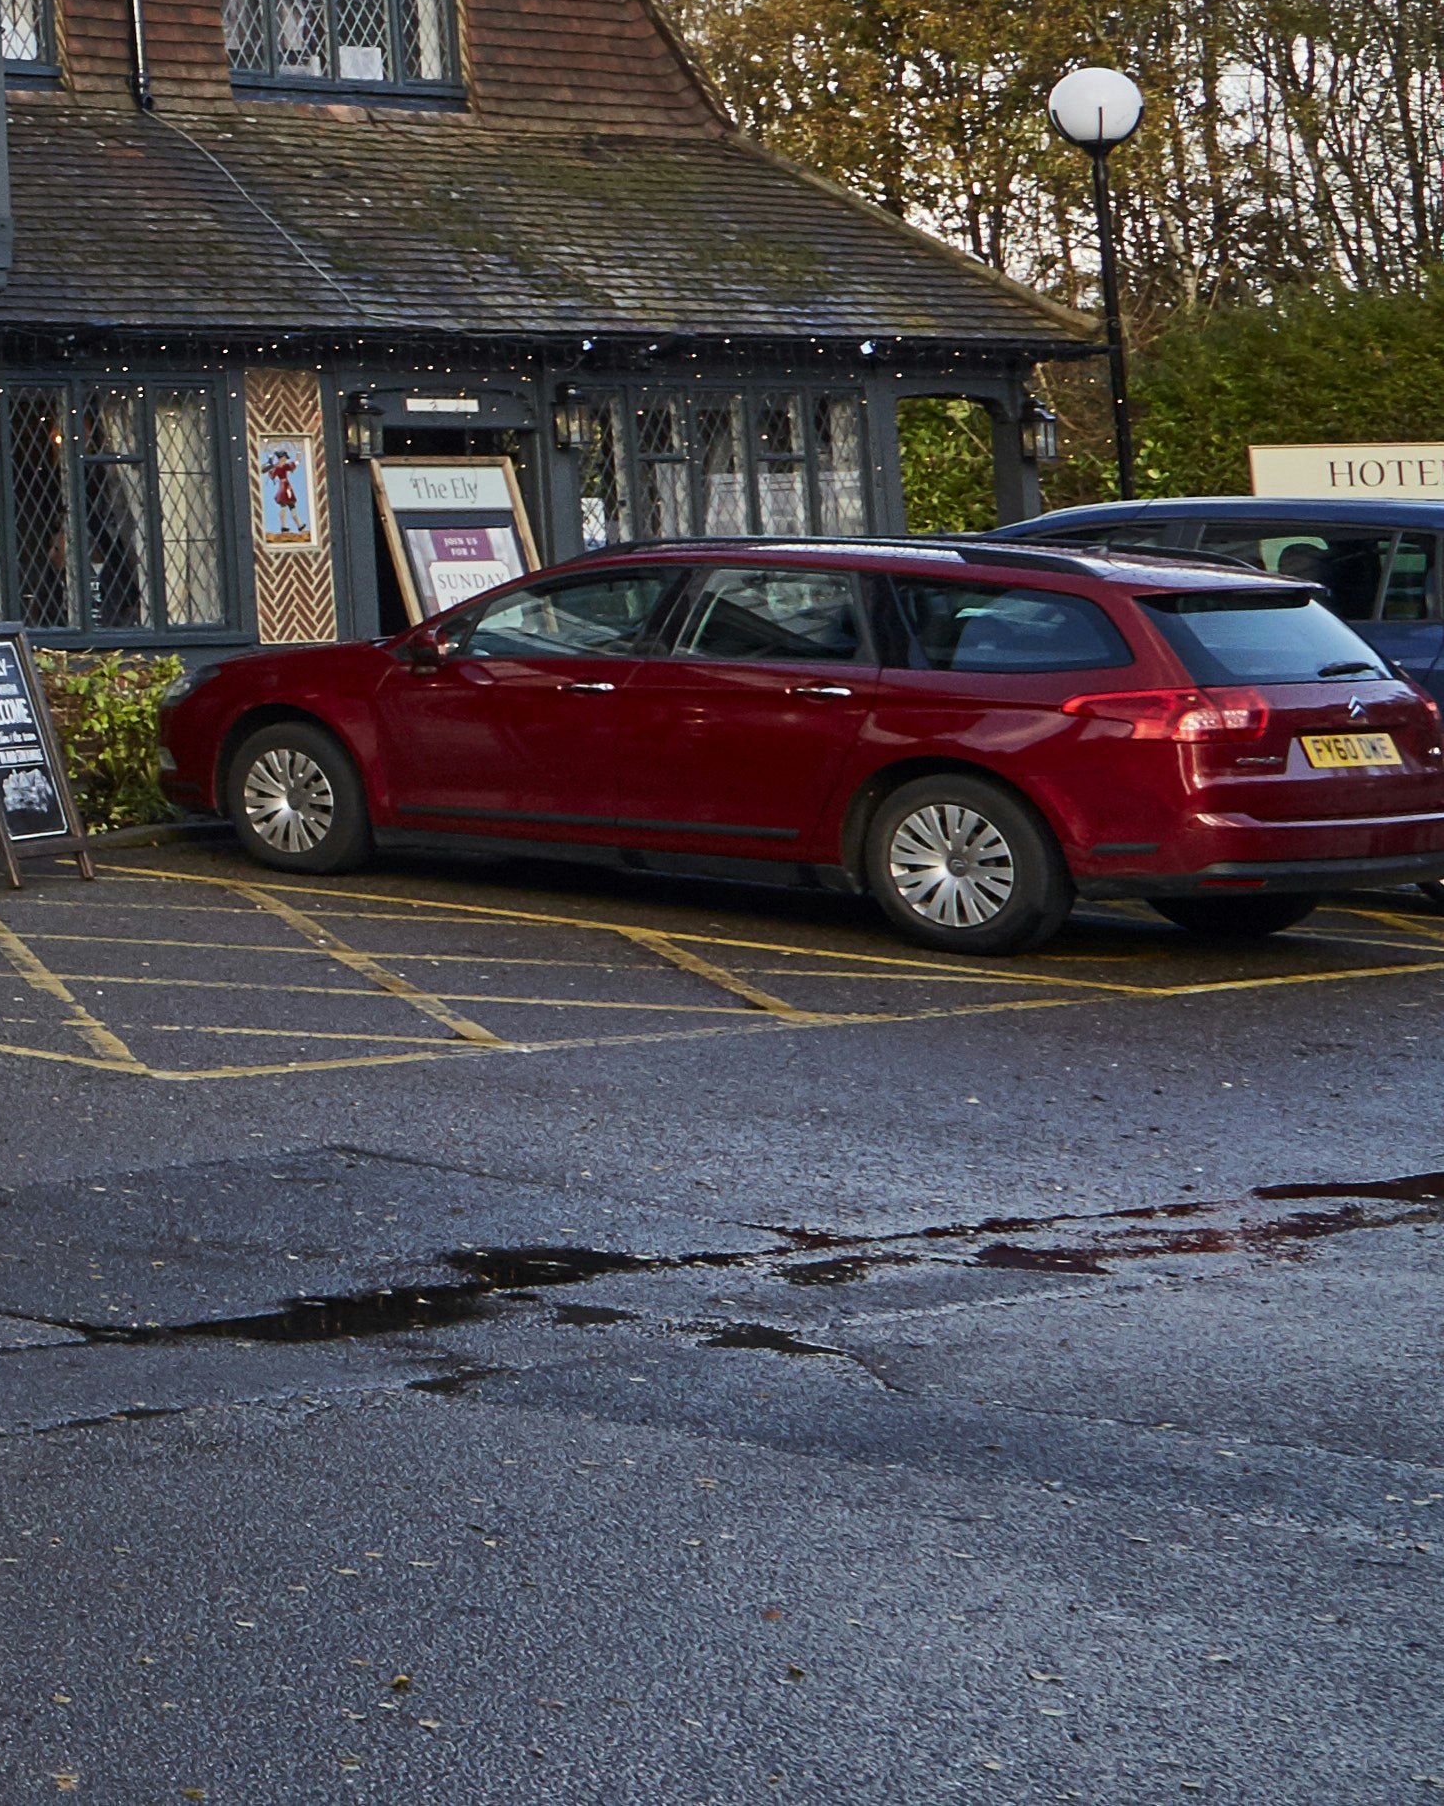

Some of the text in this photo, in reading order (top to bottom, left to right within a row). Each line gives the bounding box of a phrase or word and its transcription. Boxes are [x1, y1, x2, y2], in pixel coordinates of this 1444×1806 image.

[1328, 459, 1444, 487] HOTE
[410, 476, 478, 504] The Ely
[444, 537, 478, 547] JOIN US
[451, 547, 477, 557] FOR A
[437, 573, 505, 590] SUNDAY
[1310, 736, 1359, 762] FY60
